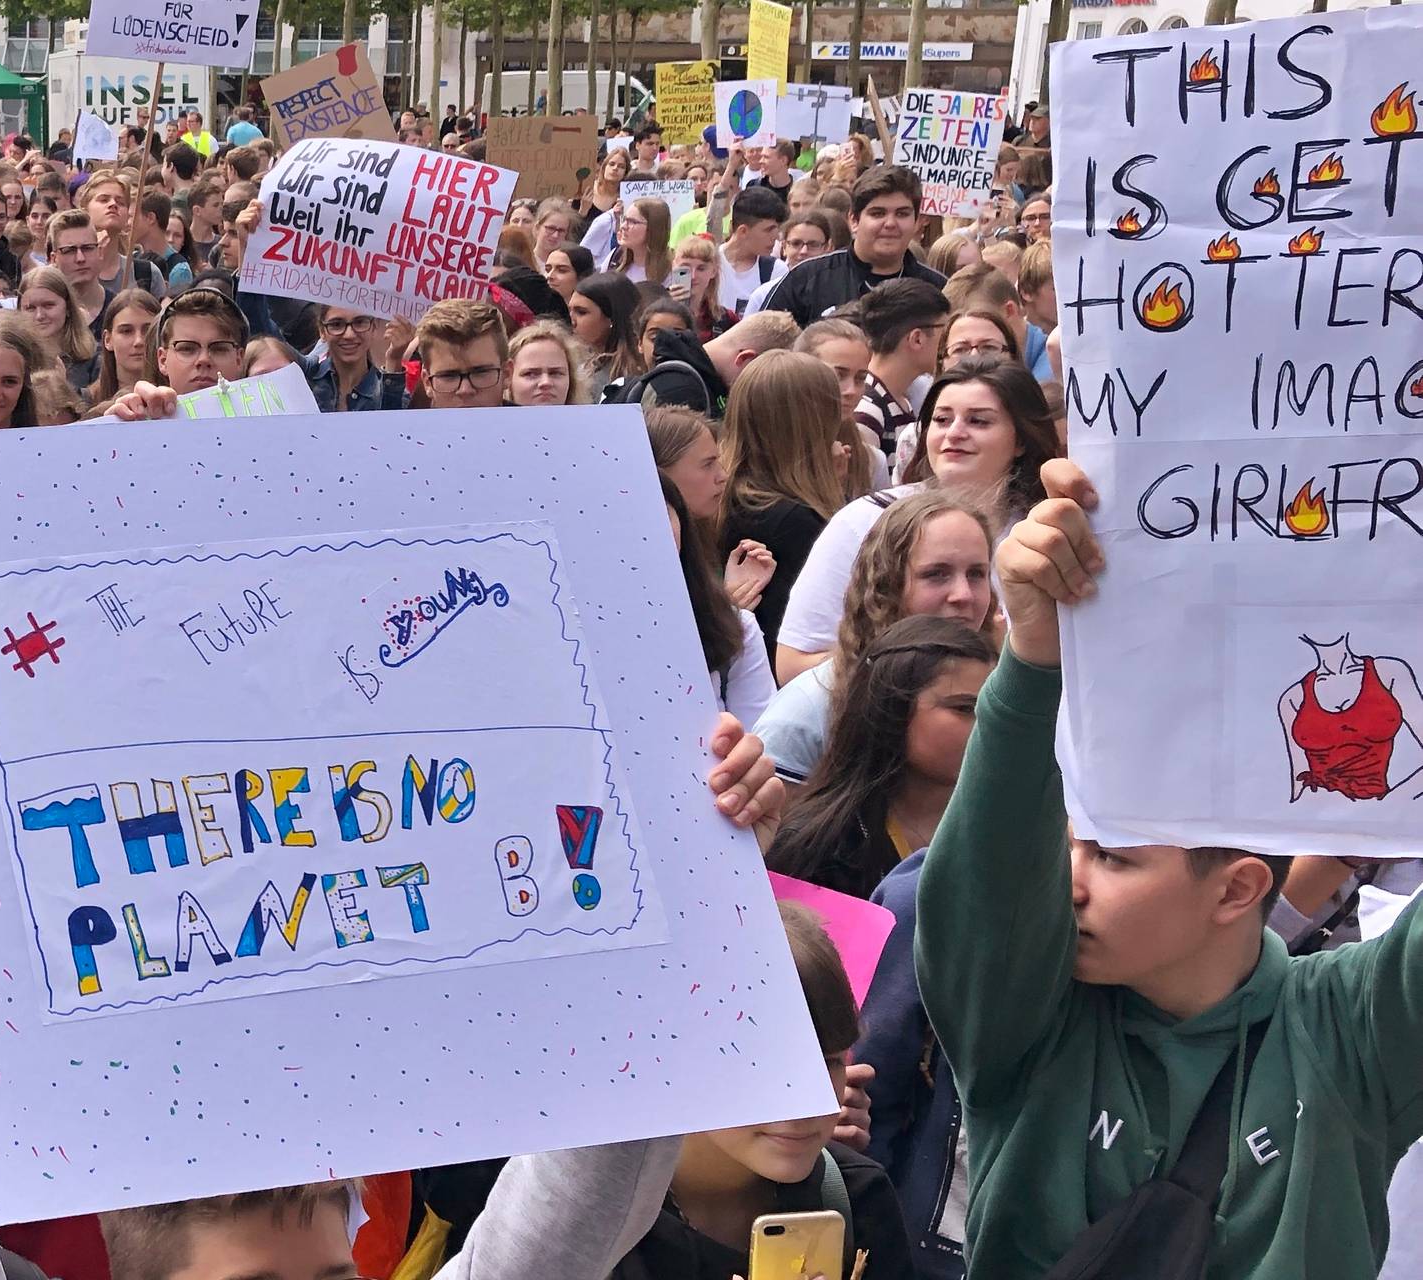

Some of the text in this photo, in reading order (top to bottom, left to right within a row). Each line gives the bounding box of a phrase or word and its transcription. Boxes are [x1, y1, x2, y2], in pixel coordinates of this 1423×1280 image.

[832, 45, 896, 57] ZEMAN
[1092, 25, 1334, 128] THIS
[85, 74, 199, 105] INSEL
[272, 76, 341, 119] RESPECT
[906, 93, 934, 114] DIE
[277, 162, 505, 243] Wir sind LAUT
[296, 141, 337, 164] Wir
[338, 144, 400, 179] sind
[412, 154, 500, 205] HIER
[625, 182, 650, 195] SAVE
[652, 181, 667, 191] THE
[1085, 132, 1423, 241] IS GET
[262, 226, 415, 293] ZUKUNFT
[270, 192, 494, 280] Weil ihr UNSERE
[1066, 366, 1167, 436] MY
[86, 583, 146, 636] THE
[18, 754, 475, 889] THERE IS NO
[68, 862, 430, 998] PLANET
